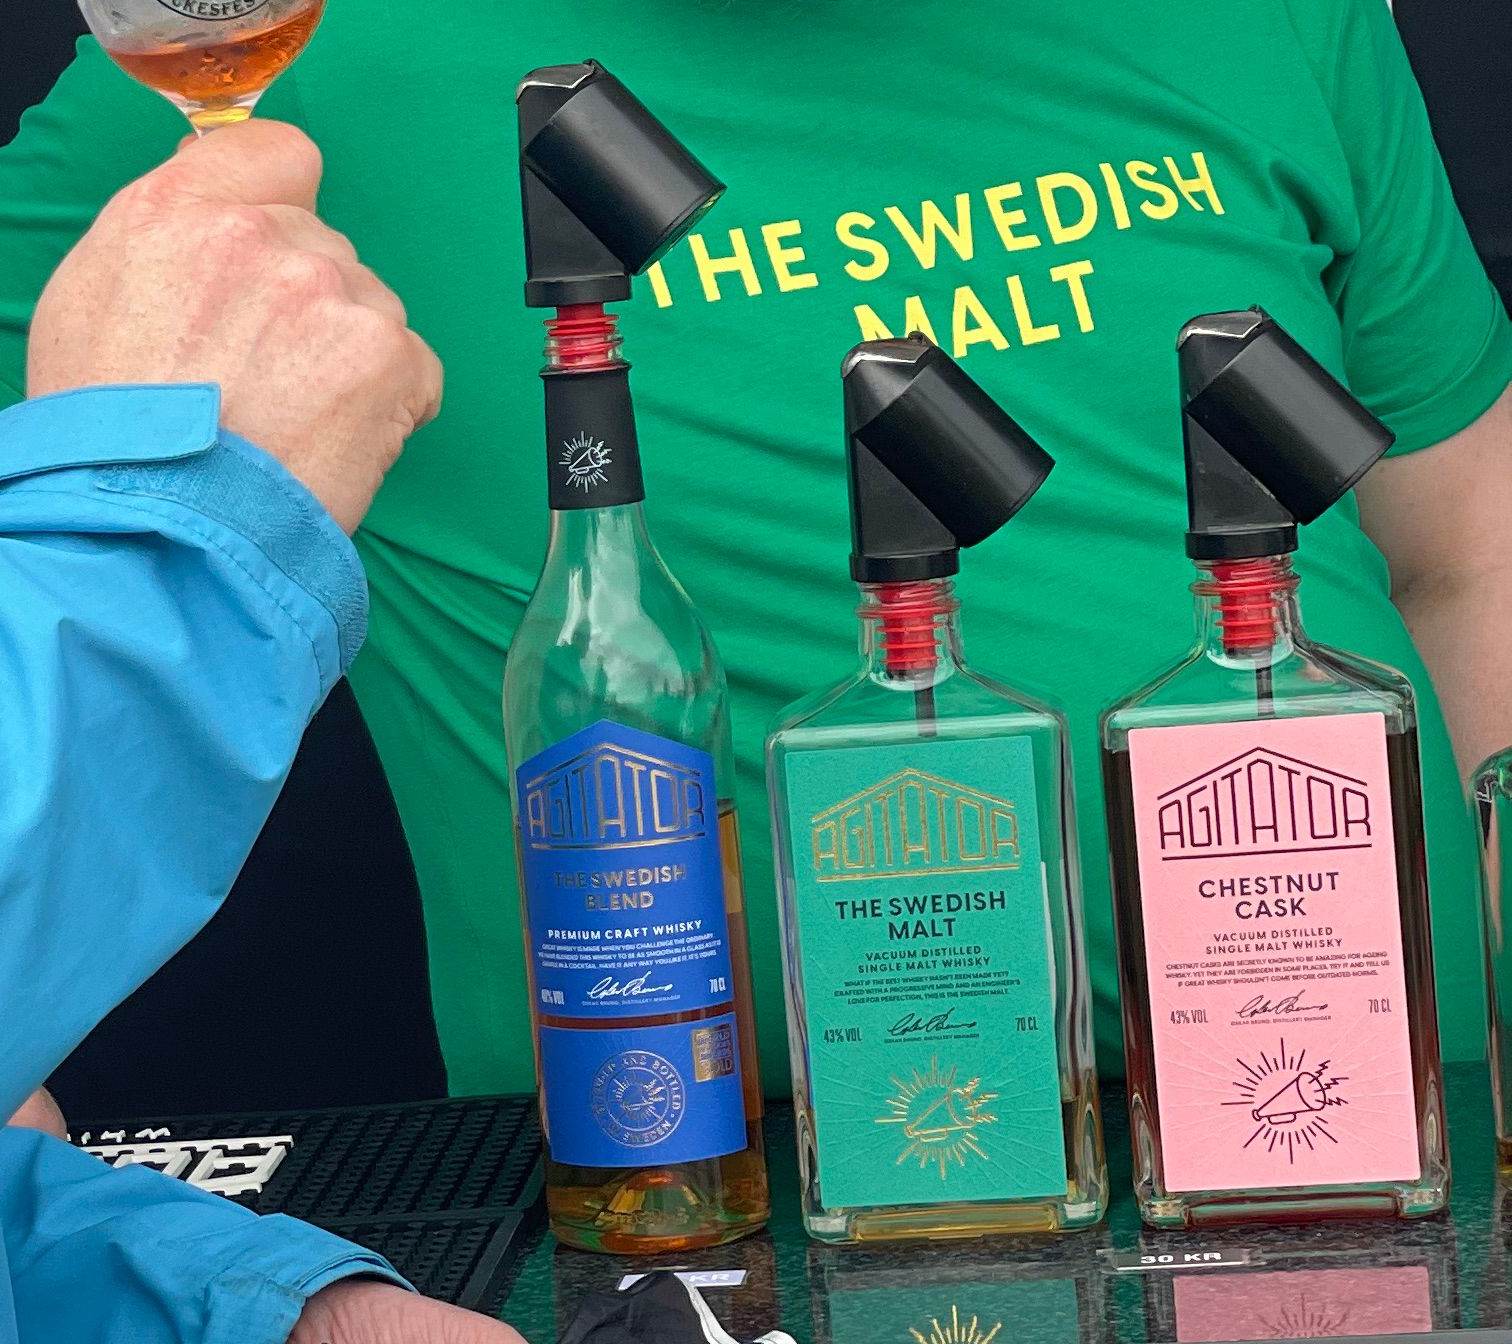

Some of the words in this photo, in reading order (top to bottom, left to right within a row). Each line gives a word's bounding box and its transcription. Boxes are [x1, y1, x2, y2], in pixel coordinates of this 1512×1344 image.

[836, 152, 1225, 282] SWEDISH
[527, 753, 705, 838] AGITATOR
[1158, 758, 1371, 849] AGITATOR
[812, 780, 1020, 870] AGITATOR
[553, 871, 591, 888] THE
[591, 864, 686, 888] SWEDISH
[1198, 872, 1339, 899] CHESTNUT
[586, 891, 654, 911] BLEND
[835, 898, 883, 920] THE
[889, 890, 1006, 917] SWEDISH
[1235, 897, 1307, 920] CASK
[548, 928, 601, 941] PREMIUM
[605, 926, 648, 939] CRAFT
[653, 919, 703, 936] WHISKY
[888, 918, 957, 941] MALT
[1213, 931, 1267, 943] VACUUM
[1271, 927, 1333, 939] DISTILLED
[865, 950, 917, 961] VACUUM
[921, 945, 981, 958] DISTILLED
[1206, 943, 1252, 955] SINGLE
[1255, 941, 1288, 952] MALT
[1292, 938, 1343, 950] WHISKY
[858, 962, 902, 974] SINGLE
[906, 959, 938, 971] MALT
[942, 956, 991, 968] WHISKY
[1368, 999, 1380, 1013] 70
[1381, 999, 1392, 1013] CL
[1015, 1017, 1026, 1032] 70
[1027, 1016, 1039, 1031] CL
[1170, 1010, 1190, 1025] 43%
[1190, 1009, 1208, 1024] VOL
[823, 1028, 844, 1044] 43%
[844, 1027, 863, 1042] VOL
[652, 1059, 682, 1111] BOTTLED
[1140, 1254, 1174, 1264] 30
[1184, 1252, 1222, 1262] KR
[689, 1273, 729, 1283] KR
